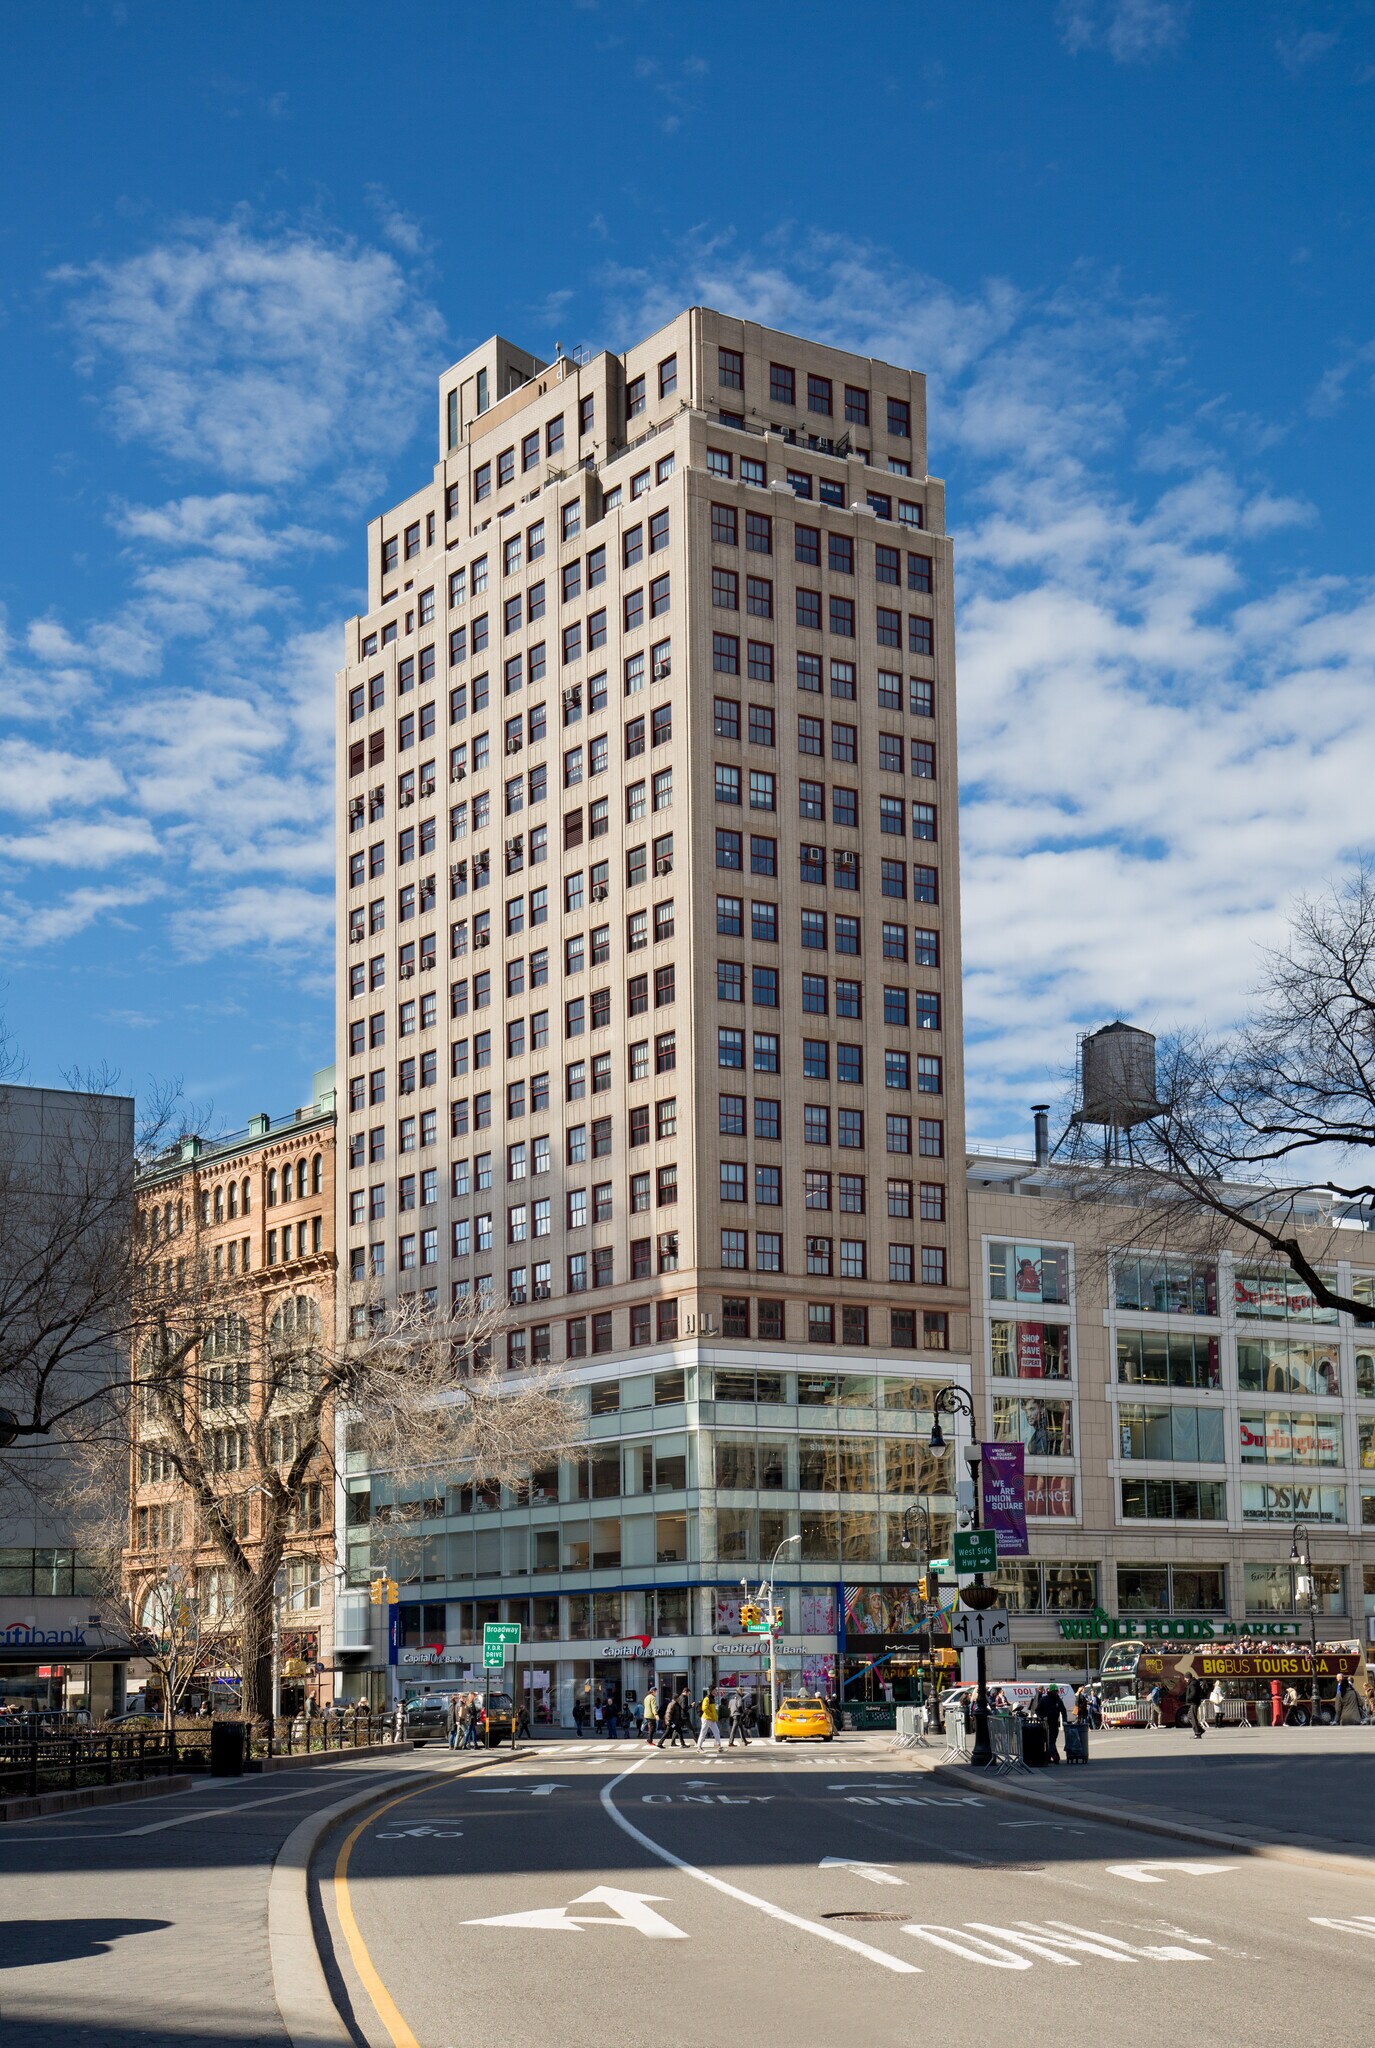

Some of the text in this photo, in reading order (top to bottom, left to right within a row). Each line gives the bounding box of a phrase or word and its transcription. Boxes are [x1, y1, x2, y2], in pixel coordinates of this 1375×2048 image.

[1021, 1335, 1040, 1343] SHOP
[1022, 1346, 1041, 1355] SAVE
[1022, 1358, 1041, 1367] REPEAT
[1240, 1425, 1334, 1455] Burlington
[992, 1480, 1005, 1488] WE
[1000, 1487, 1015, 1495] ARE
[985, 1495, 1011, 1503] UNION
[1261, 1485, 1313, 1509] DSW
[992, 1502, 1024, 1511] SQUARE
[958, 1546, 992, 1556] West Side
[962, 1559, 977, 1567] Hwy
[486, 1626, 519, 1635] Broadway
[1059, 1617, 1303, 1641] WHOLE FOODS MARKET
[653, 1648, 676, 1656] Bank
[782, 1646, 809, 1654] Bank
[446, 1655, 464, 1663] Bank
[1253, 1658, 1299, 1672] TOURS
[641, 1794, 776, 1804] ONLY
[844, 1796, 986, 1807] ONLY
